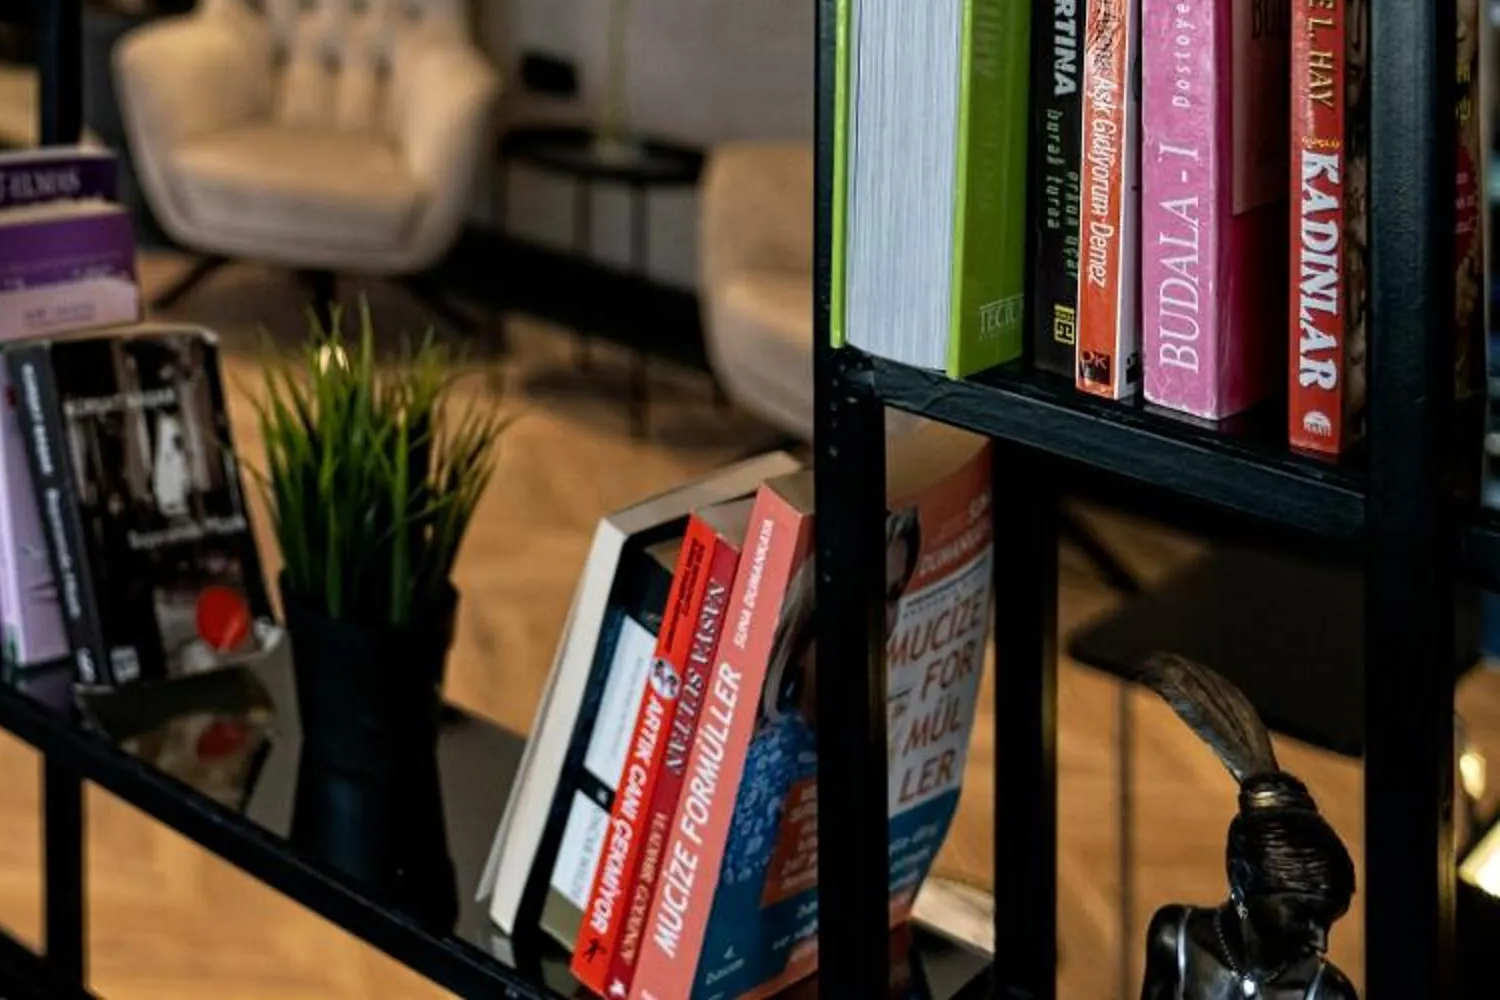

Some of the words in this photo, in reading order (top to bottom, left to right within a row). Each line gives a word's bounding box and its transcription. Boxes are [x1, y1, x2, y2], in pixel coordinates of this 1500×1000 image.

[1087, 74, 1118, 117] Aşk
[1308, 52, 1335, 109] HAY
[1086, 222, 1115, 289] Demez
[1159, 196, 1200, 374] BUDALA
[1299, 150, 1341, 391] KADINLAR
[920, 638, 976, 701] FOR
[636, 692, 665, 766] ARTIK
[665, 667, 705, 776] SULTAN
[903, 696, 963, 758] MÜL
[620, 763, 648, 821] CANI
[898, 747, 957, 805] LER
[653, 840, 699, 960] MUCİZE
[680, 661, 742, 846] FORMÜLLER
[589, 817, 634, 936] ÇEKMİYOR
